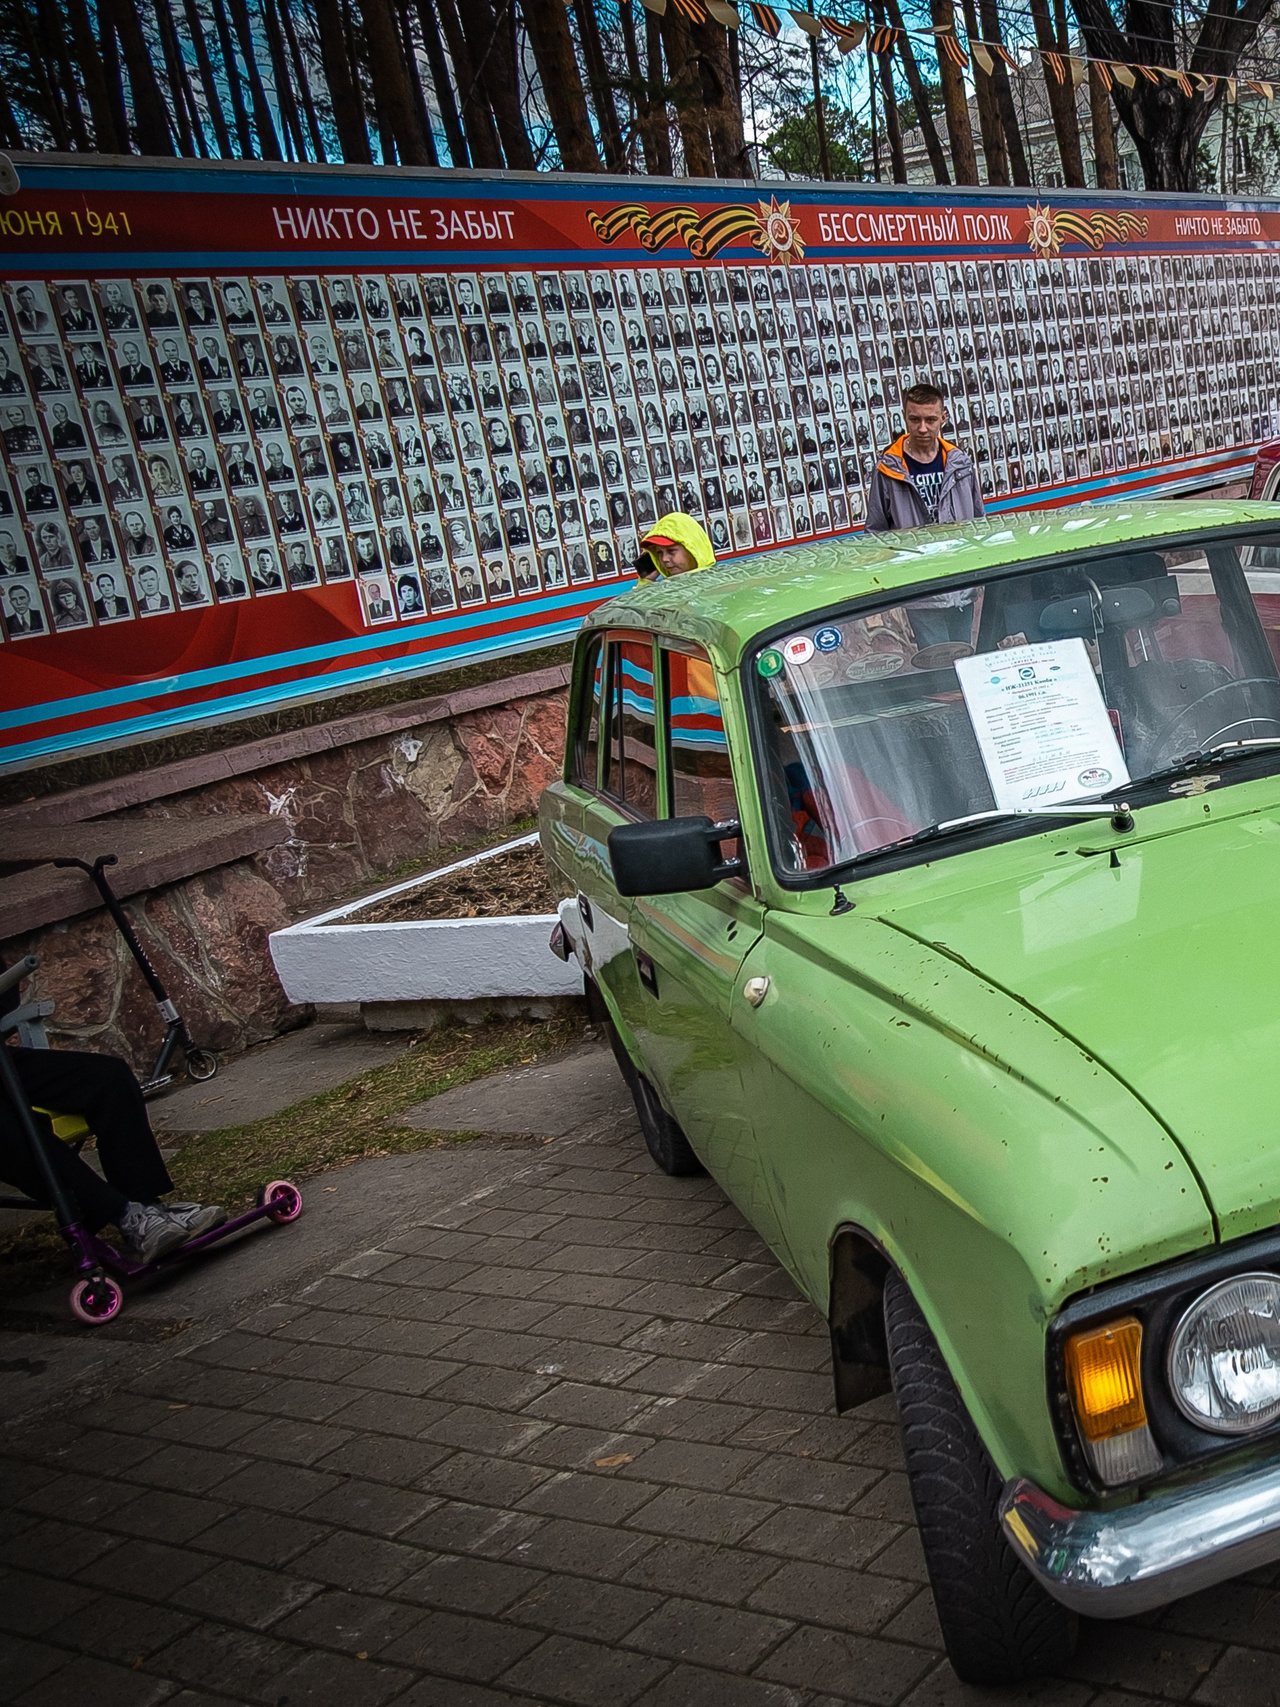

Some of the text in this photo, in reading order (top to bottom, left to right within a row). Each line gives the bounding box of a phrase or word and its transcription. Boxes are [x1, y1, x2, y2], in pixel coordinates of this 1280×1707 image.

[71, 210, 132, 236] 1941
[271, 206, 515, 240] НИКТО НЕ ЗАБЫТ
[817, 207, 1013, 242] БЕССМЕРТНЫЙ ПОЛК
[1175, 217, 1261, 236] НИЧТО НЕ ЗАБЫТО
[916, 472, 935, 485] CITY
